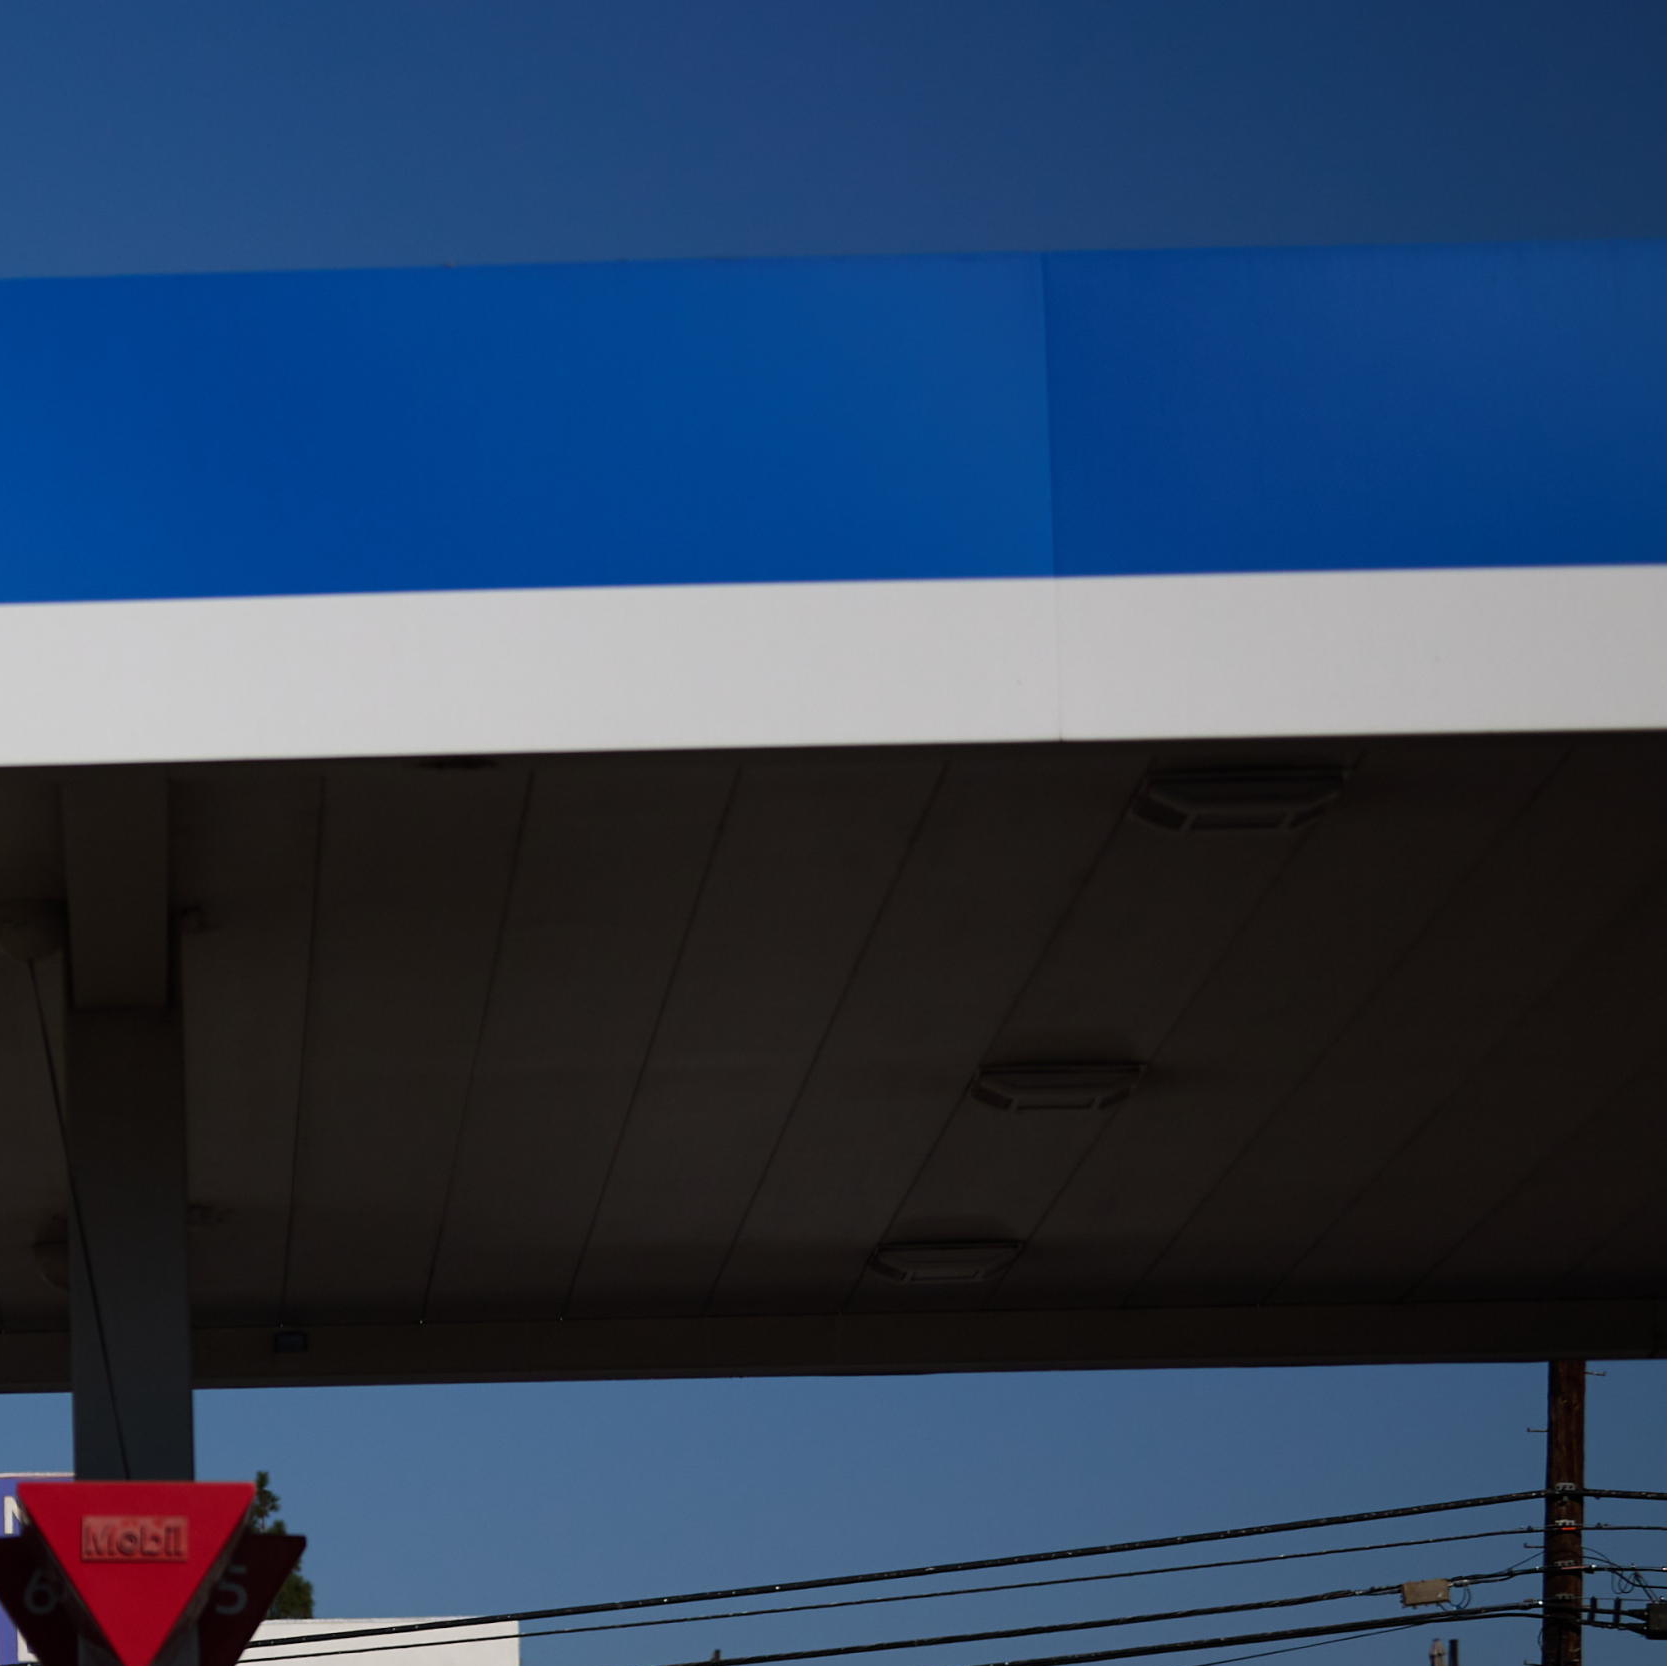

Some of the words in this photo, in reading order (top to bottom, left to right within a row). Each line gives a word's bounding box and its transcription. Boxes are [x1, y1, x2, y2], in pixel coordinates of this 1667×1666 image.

[85, 1519, 184, 1558] Mobil
[24, 1567, 58, 1615] 6
[216, 1566, 249, 1615] 5
